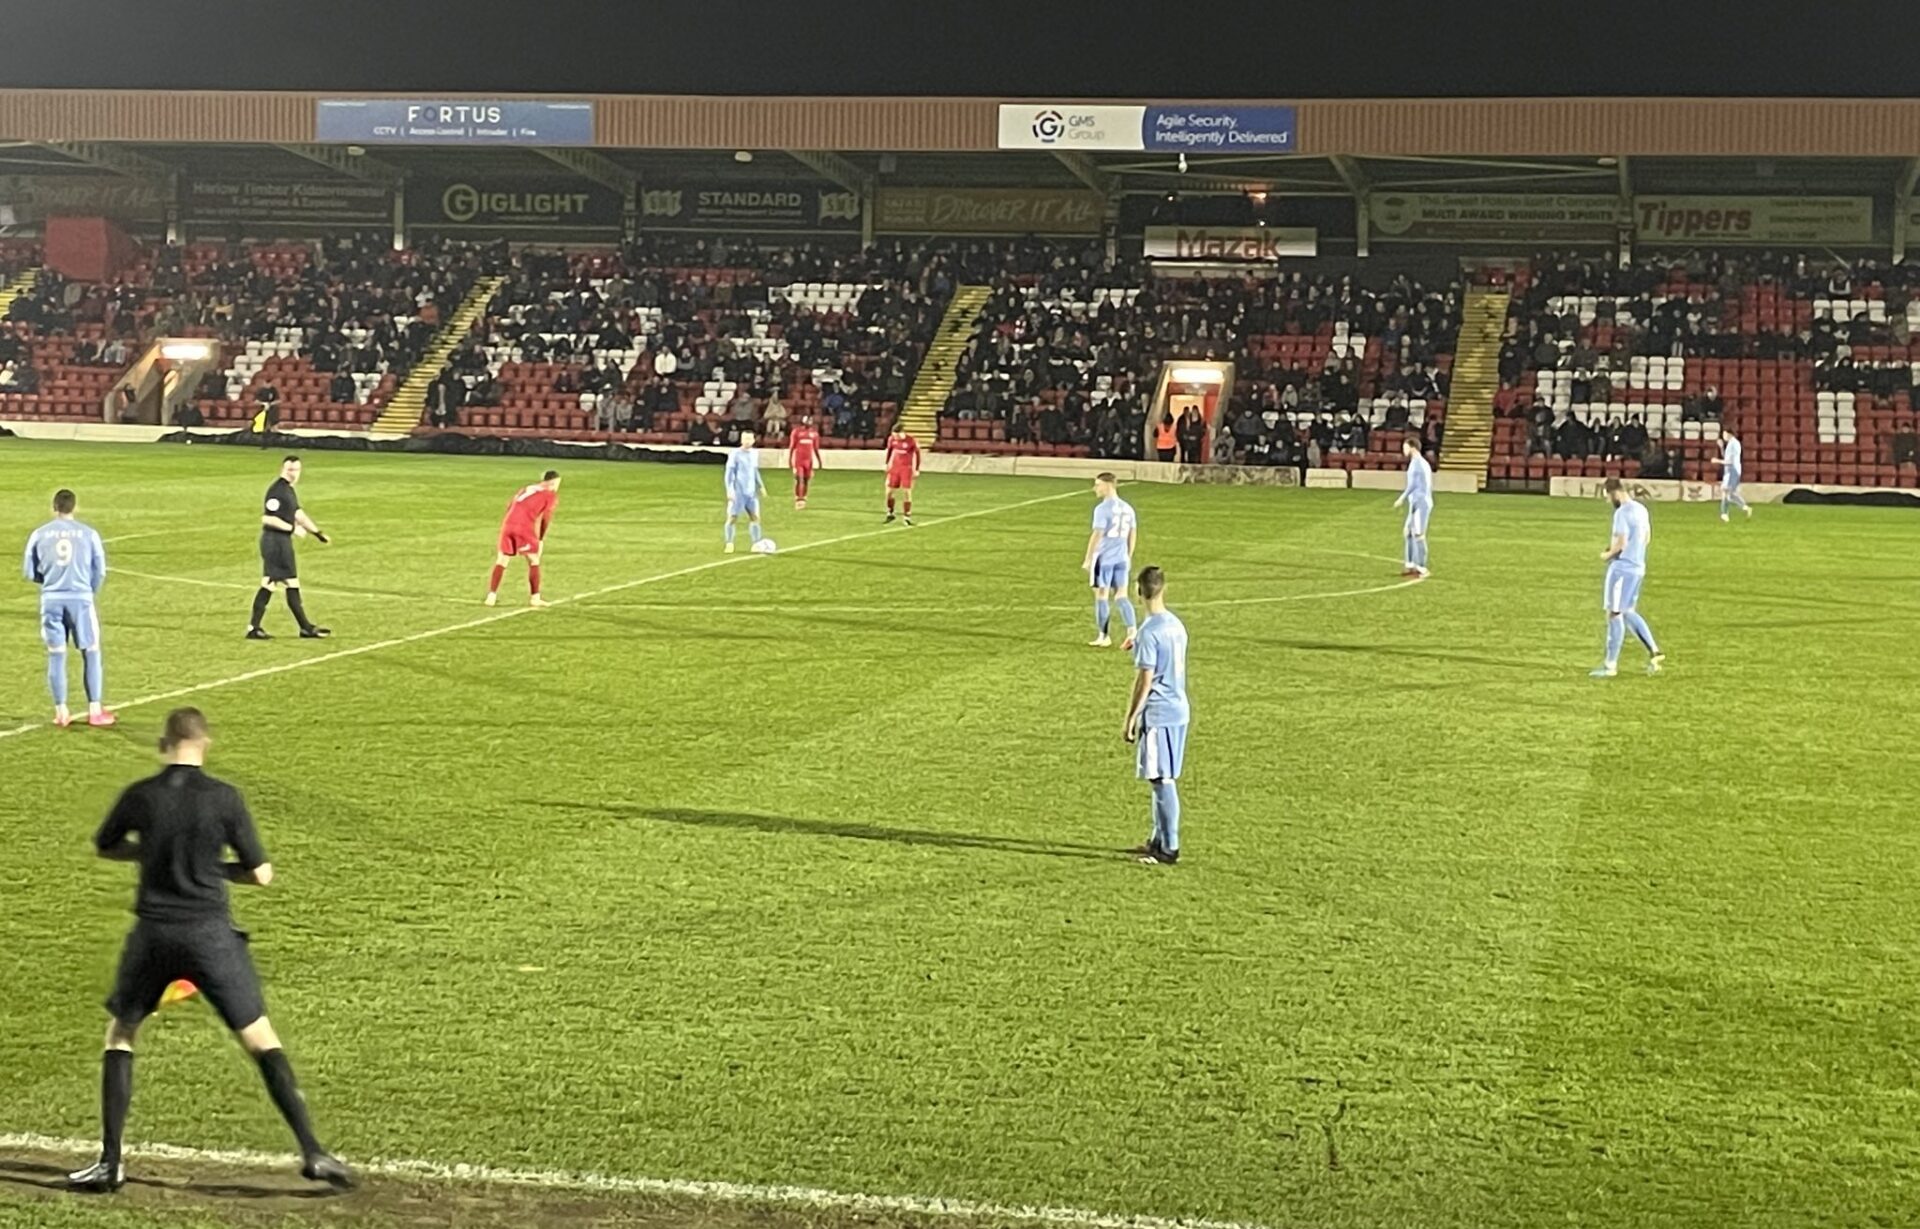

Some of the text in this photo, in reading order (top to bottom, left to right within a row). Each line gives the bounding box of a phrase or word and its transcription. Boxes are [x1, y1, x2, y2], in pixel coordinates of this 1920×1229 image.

[408, 106, 501, 123] FORTUS
[1069, 115, 1095, 127] GMS
[1156, 114, 1186, 127] Agile
[373, 127, 397, 136] CCTV
[1069, 129, 1105, 141] Group
[1156, 131, 1288, 145] Intelligently Delivered
[698, 191, 802, 207] STANDARD
[1459, 208, 1505, 221] AWARD
[1638, 201, 1752, 238] Tippers
[1176, 229, 1282, 258] Mazak
[1106, 515, 1132, 538] 25
[55, 538, 73, 567] 9
